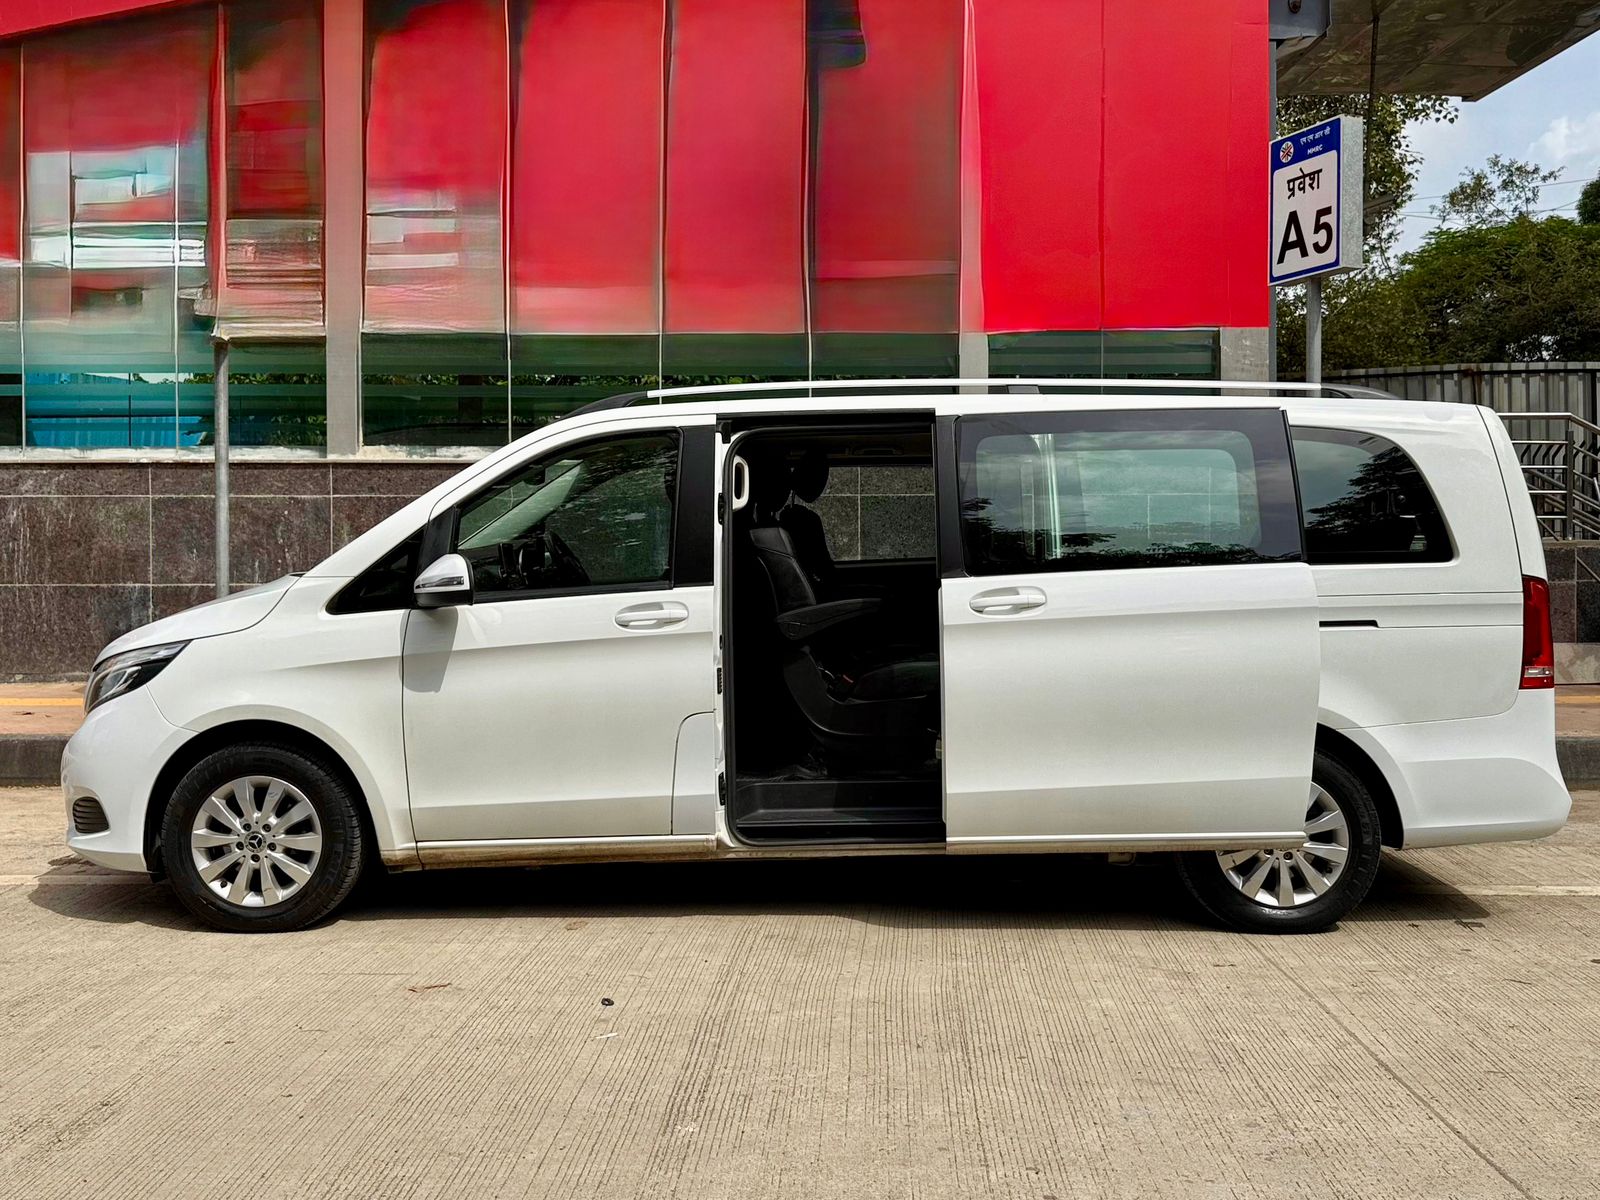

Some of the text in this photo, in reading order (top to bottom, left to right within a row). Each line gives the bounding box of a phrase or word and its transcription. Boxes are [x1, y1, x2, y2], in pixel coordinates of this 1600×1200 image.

[1307, 144, 1323, 155] MMRC
[1286, 167, 1323, 200] प्रवेश
[1276, 205, 1334, 265] A5
